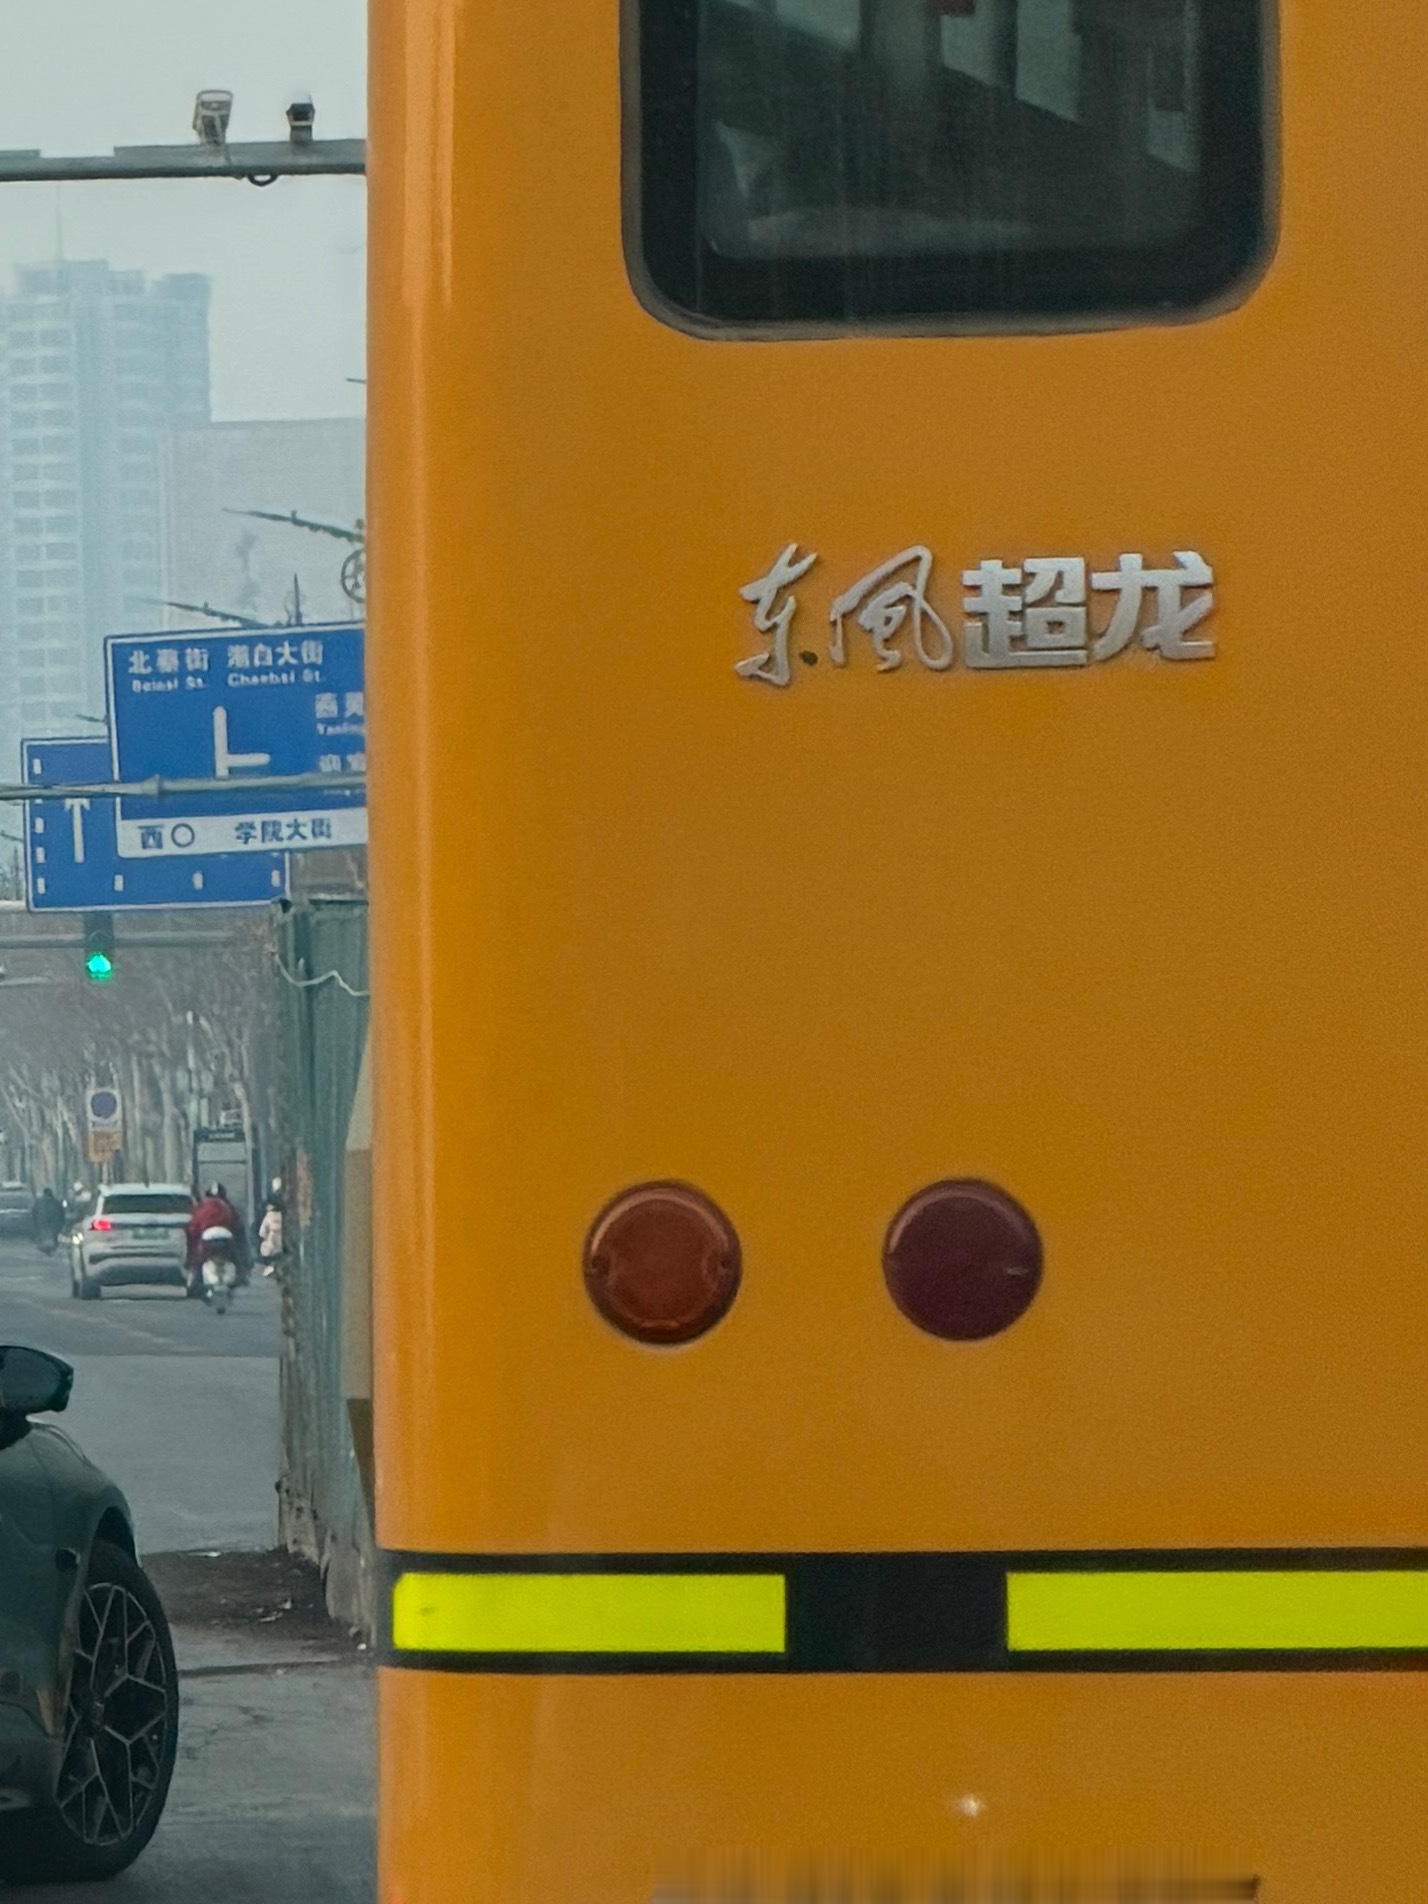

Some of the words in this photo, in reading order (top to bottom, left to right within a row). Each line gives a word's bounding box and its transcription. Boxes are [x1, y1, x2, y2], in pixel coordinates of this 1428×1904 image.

[734, 542, 1215, 686] 东风超龙
[137, 824, 163, 849] 西
[235, 818, 332, 844] 学院大街
